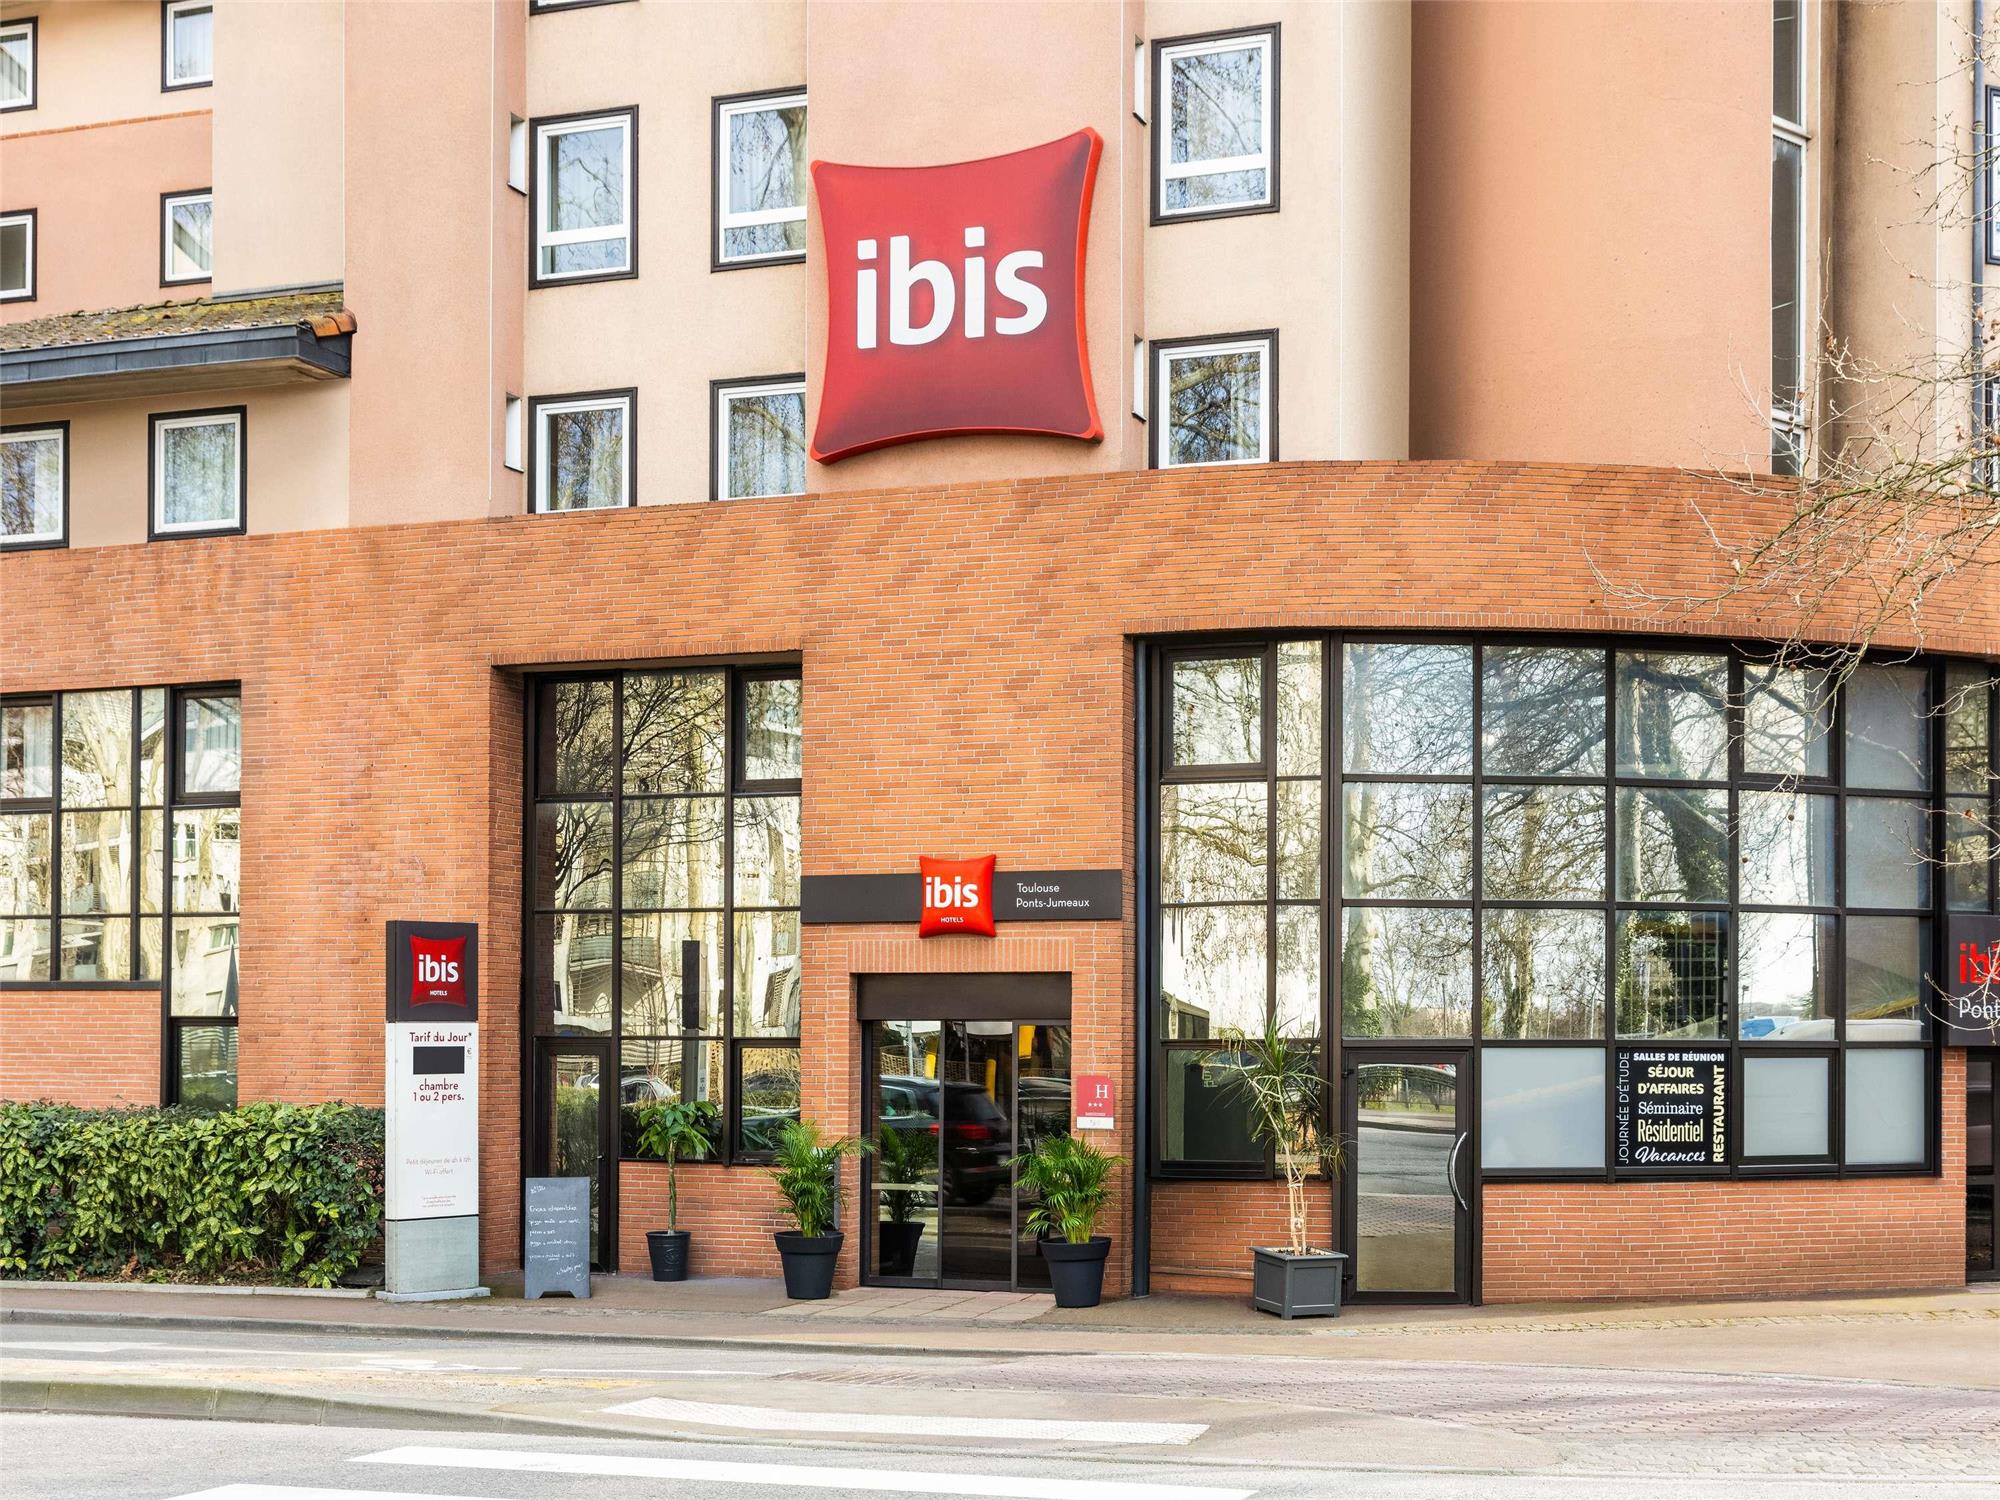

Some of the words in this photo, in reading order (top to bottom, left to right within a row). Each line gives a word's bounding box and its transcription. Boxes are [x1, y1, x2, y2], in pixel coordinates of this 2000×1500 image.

[857, 226, 1048, 350] ibis
[925, 876, 979, 908] ibis
[1017, 882, 1060, 893] Toulouse
[1016, 897, 1090, 908] Ponts-Jumeaux
[418, 954, 459, 983] ibis
[409, 1031, 431, 1042] Tarif
[433, 1031, 445, 1042] du
[1633, 1053, 1666, 1061] SALLES
[1668, 1053, 1680, 1061] DE
[1682, 1051, 1725, 1062] RÉUNION
[1616, 1052, 1629, 1103] D'ÉTUDE
[1648, 1064, 1695, 1078] SÉJOUR
[419, 1077, 459, 1091] chambre
[1637, 1083, 1704, 1095] D'AFFAIRES
[413, 1092, 417, 1102] 1
[419, 1094, 431, 1102] ou
[433, 1092, 439, 1101] 2
[442, 1093, 465, 1104] pers.
[1096, 1084, 1108, 1099] H
[1638, 1101, 1703, 1115] Séminaire
[1713, 1065, 1725, 1162] RESTAURANT
[1616, 1106, 1629, 1164] JOURNÉE
[1637, 1118, 1704, 1142] Résidentiel
[1635, 1146, 1706, 1164] Vacances
